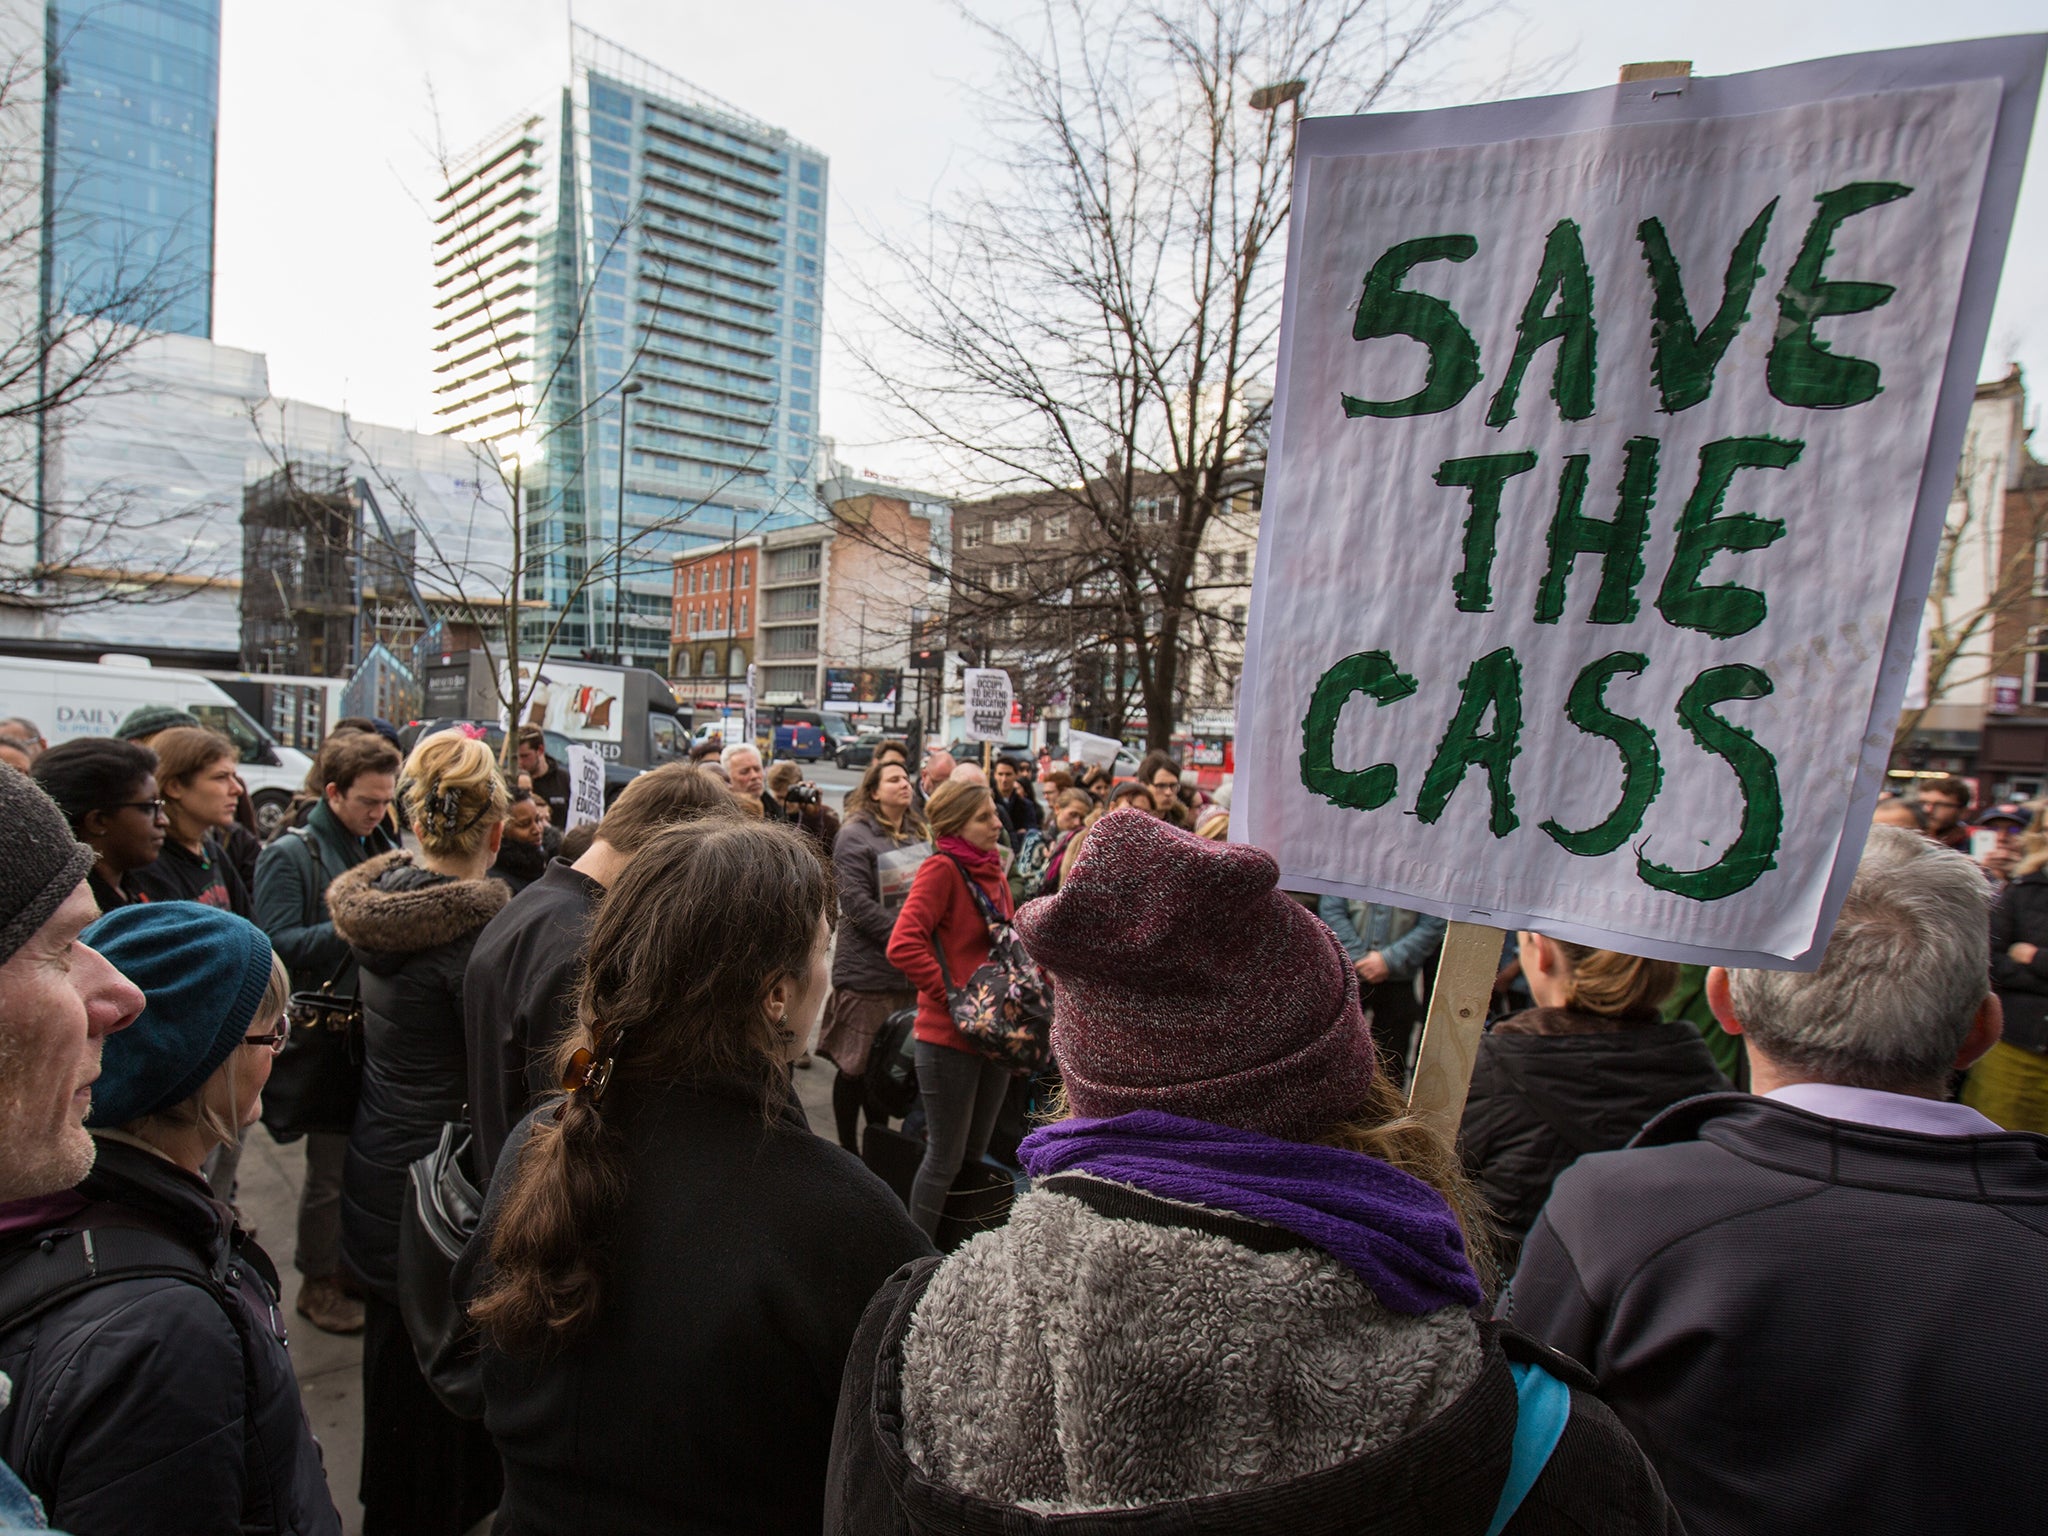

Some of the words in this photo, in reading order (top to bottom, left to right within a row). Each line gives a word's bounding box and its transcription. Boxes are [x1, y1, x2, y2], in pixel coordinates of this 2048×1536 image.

[1341, 181, 1914, 431] SAVE
[1432, 434, 1805, 640] THE
[977, 679, 1003, 690] OCCUPY
[971, 697, 1008, 709] EDUCATION
[972, 688, 981, 697] TO
[983, 688, 1009, 700] DEFEND
[57, 706, 123, 724] DAILY
[591, 741, 622, 759] BED
[1300, 646, 1783, 902] CASS
